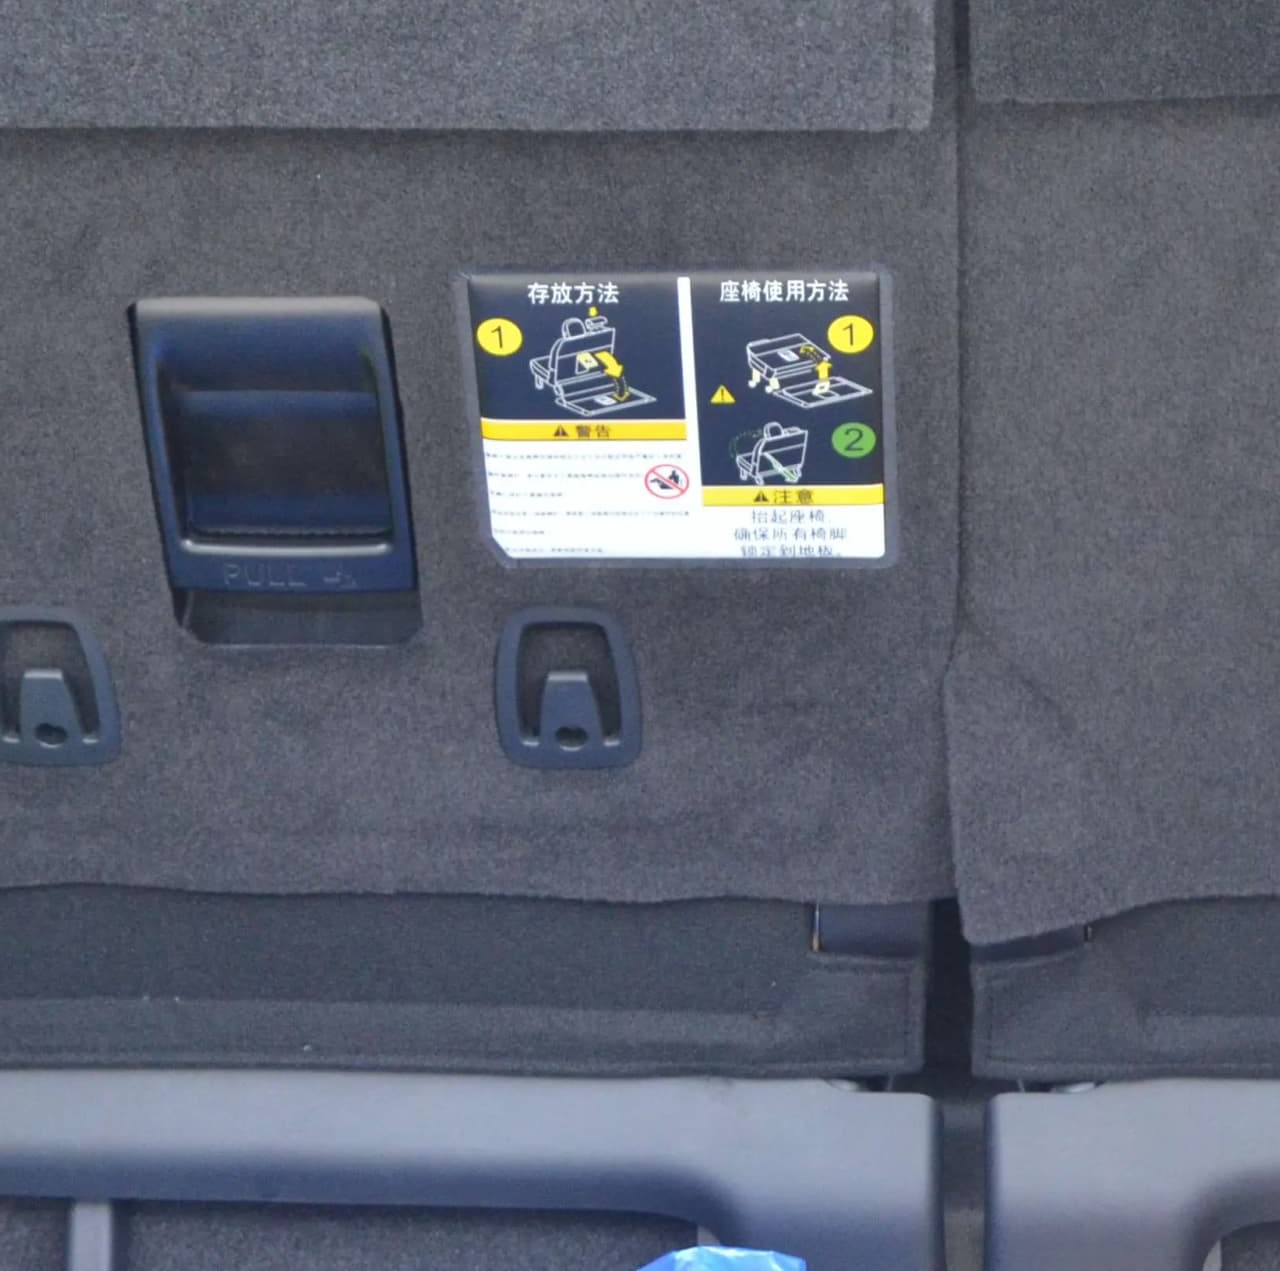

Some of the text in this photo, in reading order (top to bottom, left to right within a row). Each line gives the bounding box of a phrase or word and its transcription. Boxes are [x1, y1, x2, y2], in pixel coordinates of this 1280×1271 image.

[527, 282, 619, 305] 存放方法
[719, 279, 850, 303] 座椅使用方法
[575, 424, 611, 439] 警告
[773, 489, 815, 504] 注意
